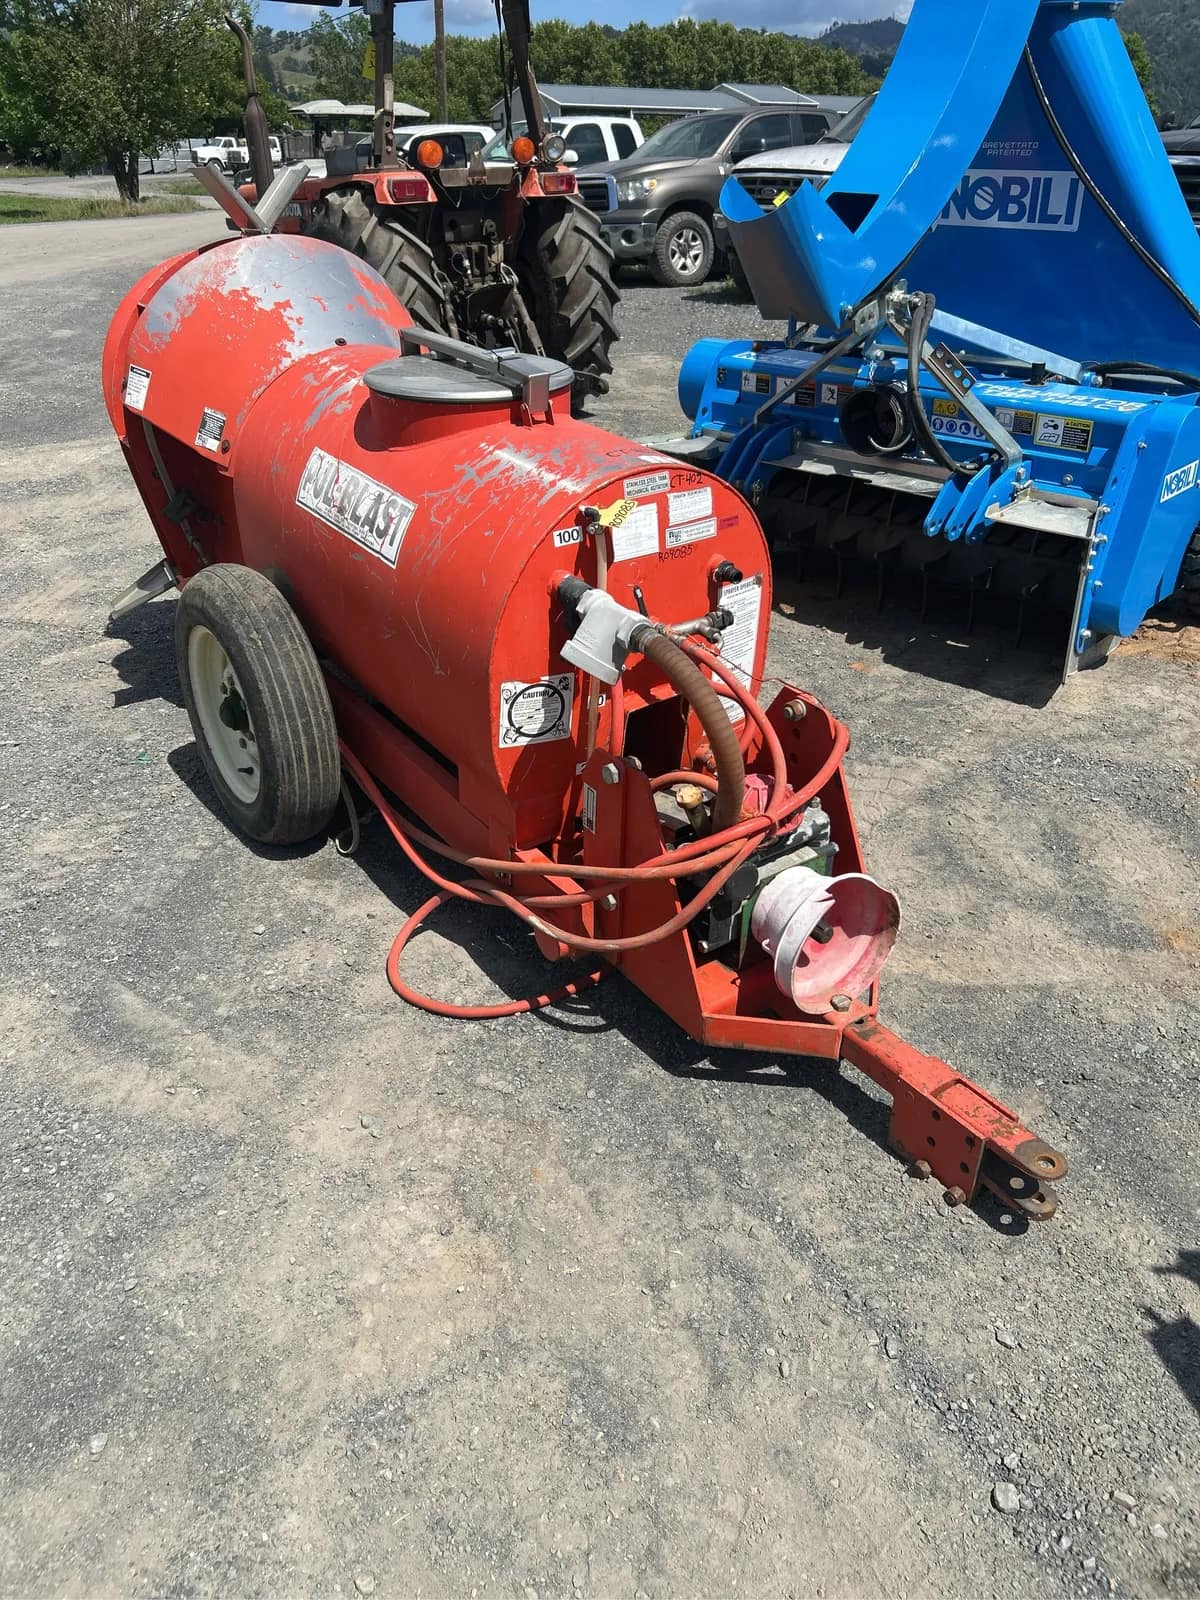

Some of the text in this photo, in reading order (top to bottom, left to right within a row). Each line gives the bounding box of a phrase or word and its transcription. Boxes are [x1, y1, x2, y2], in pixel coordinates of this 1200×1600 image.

[982, 141, 1040, 149] BREVETTATO
[941, 176, 1080, 225] NOBILI
[670, 473, 703, 488] CT-402
[1162, 463, 1197, 499] NOBILI
[556, 529, 580, 544] 100
[521, 690, 550, 700] CAUTION
